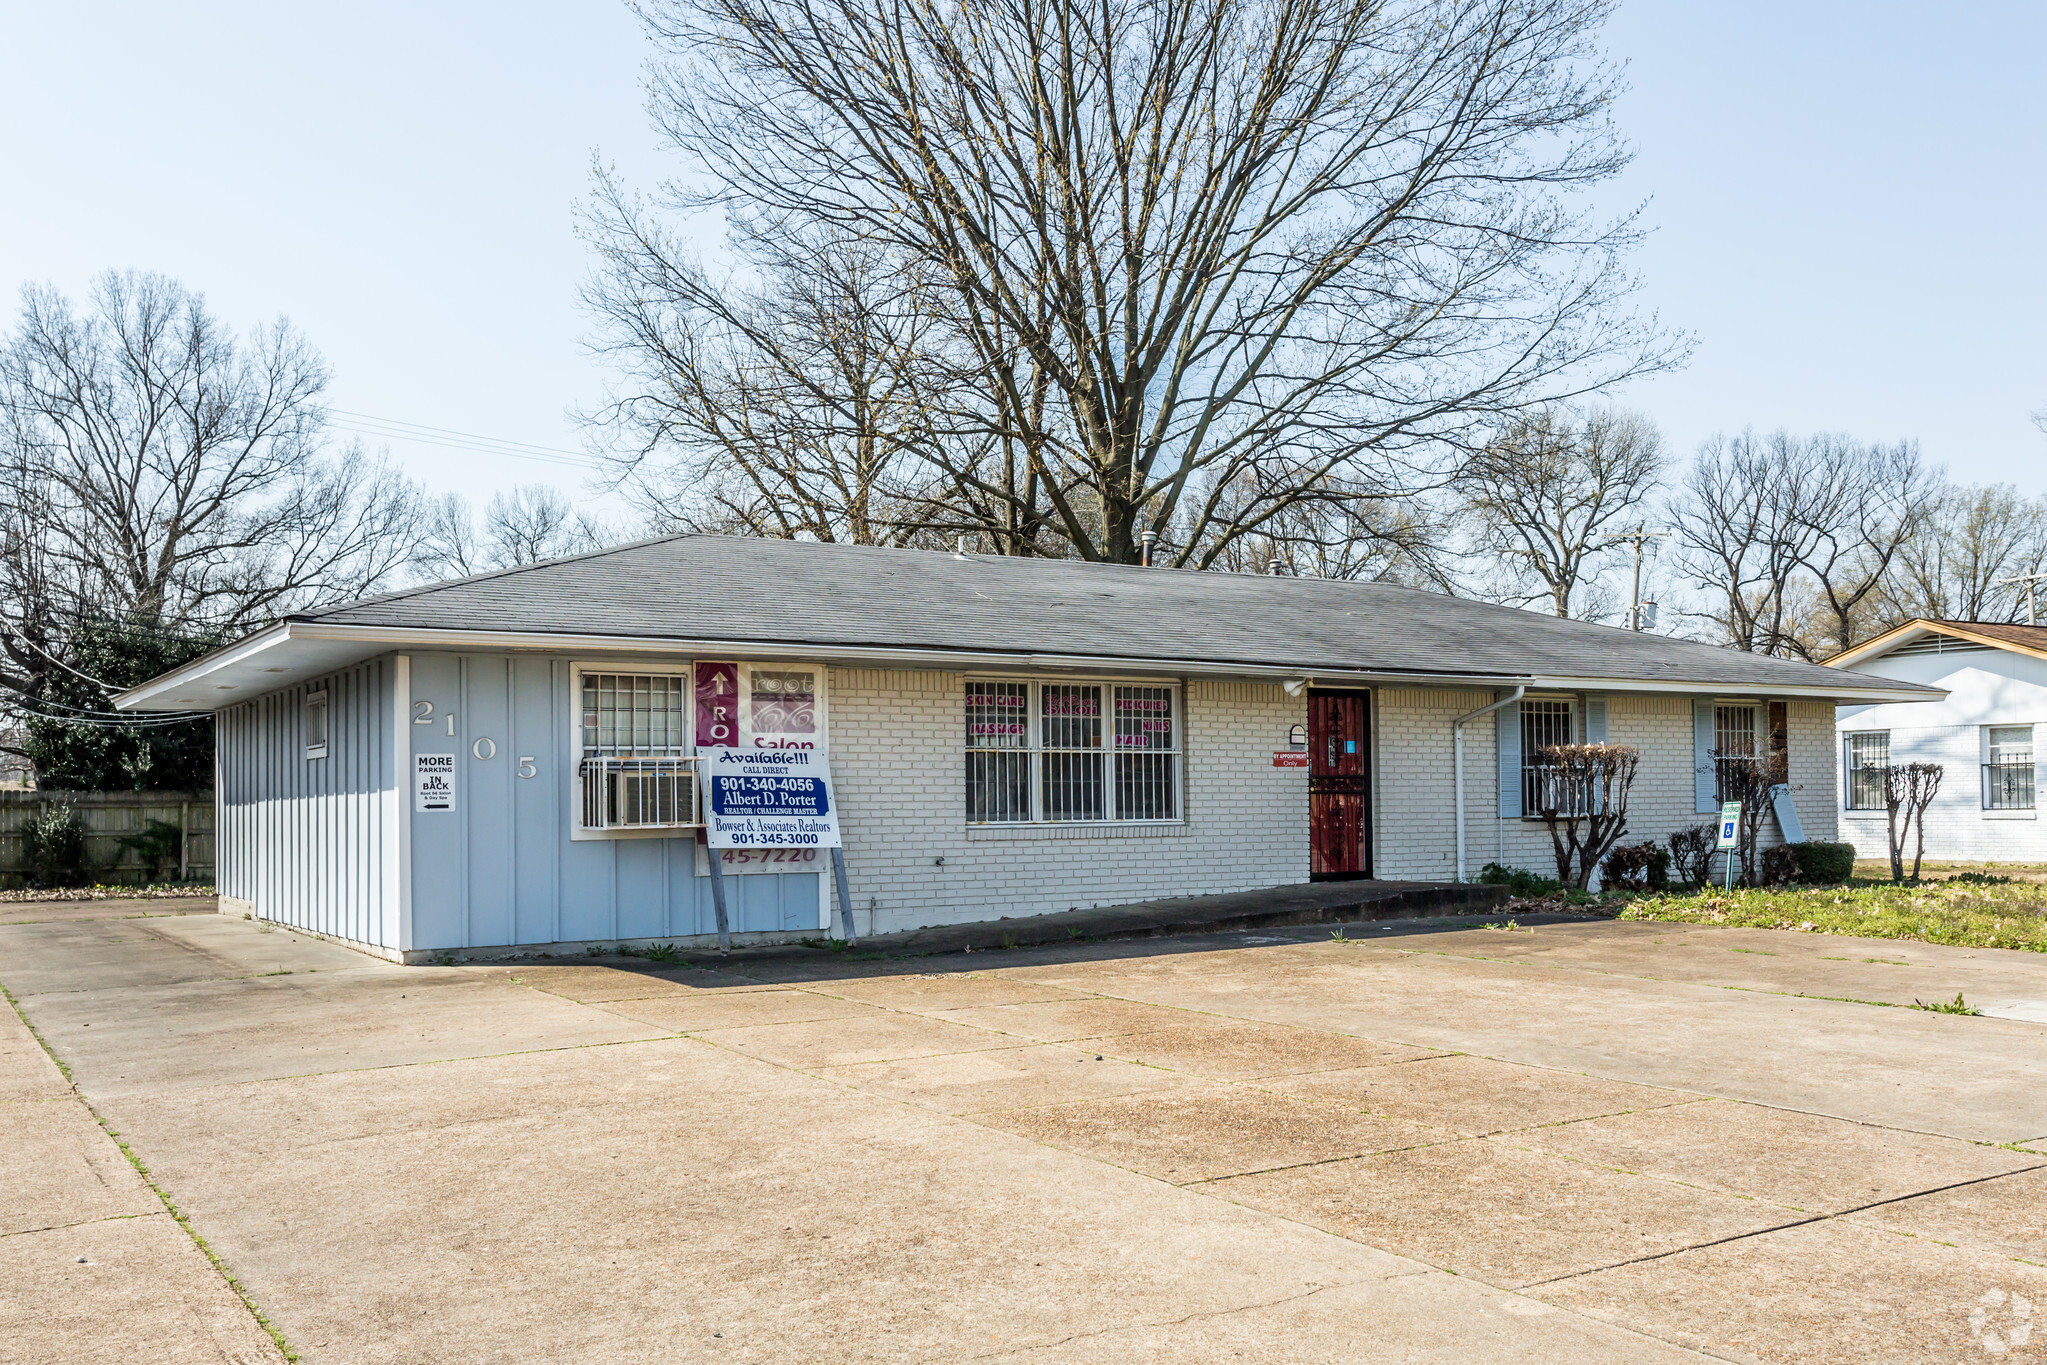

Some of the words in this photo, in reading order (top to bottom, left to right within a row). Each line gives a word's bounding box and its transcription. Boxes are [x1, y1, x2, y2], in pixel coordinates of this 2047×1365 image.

[752, 675, 814, 693] root
[967, 695, 993, 706] SKIN
[997, 696, 1024, 707] CARE
[1116, 700, 1167, 711] PEDICURES
[1046, 705, 1097, 715] SALON
[710, 707, 730, 747] RO
[970, 723, 1024, 734] MASSAGE
[1116, 735, 1148, 746] HAIR
[418, 757, 452, 765] MORE
[719, 751, 809, 765] Available!!!
[743, 766, 762, 774] CALL
[762, 766, 789, 775] DIRECT
[429, 776, 442, 784] IN
[720, 777, 814, 791] 901-340-4056
[723, 791, 762, 806] Albert
[762, 792, 779, 806] D.
[779, 791, 817, 806] Porter
[723, 807, 753, 815] REALTOR
[756, 807, 793, 815] CHALLENGE
[793, 807, 818, 815] MASTER
[715, 817, 745, 832] Bowser
[746, 818, 756, 832] &
[756, 818, 797, 833] Associates
[797, 818, 831, 833] Realtors
[731, 833, 819, 845] 901-345-3000
